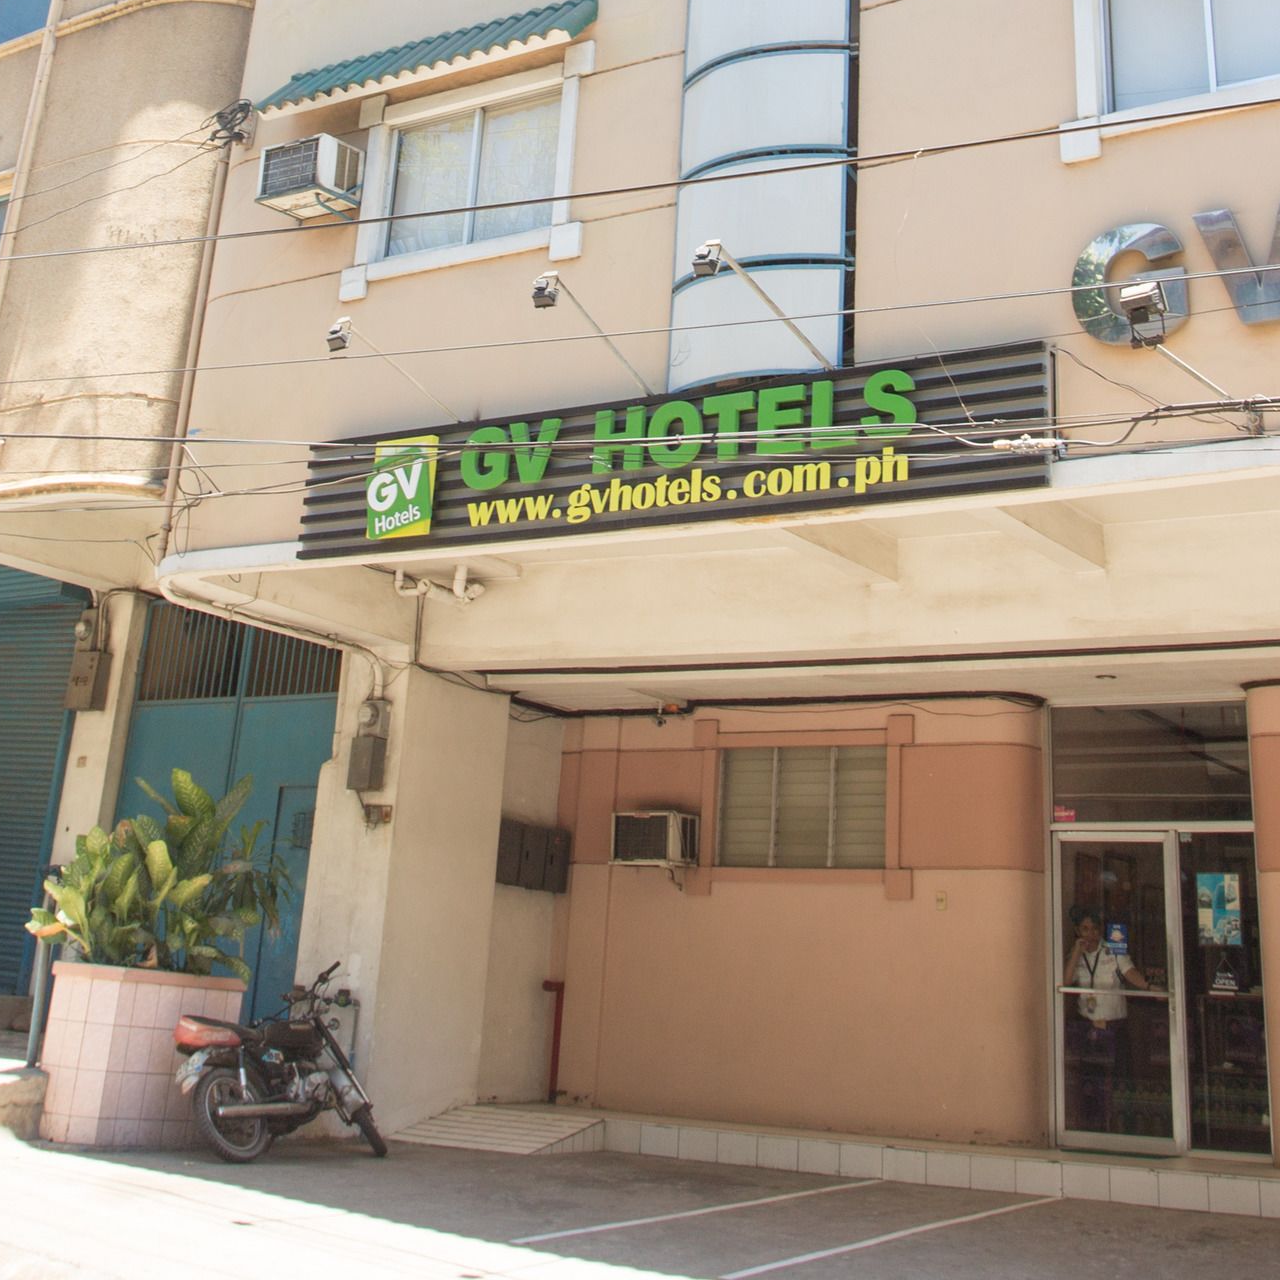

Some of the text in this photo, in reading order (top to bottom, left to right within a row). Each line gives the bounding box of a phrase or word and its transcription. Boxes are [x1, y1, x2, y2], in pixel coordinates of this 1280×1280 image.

[460, 369, 919, 492] GV HOTELS
[367, 458, 424, 512] GV
[374, 504, 421, 535] Hotels
[1215, 978, 1236, 986] OPEN
